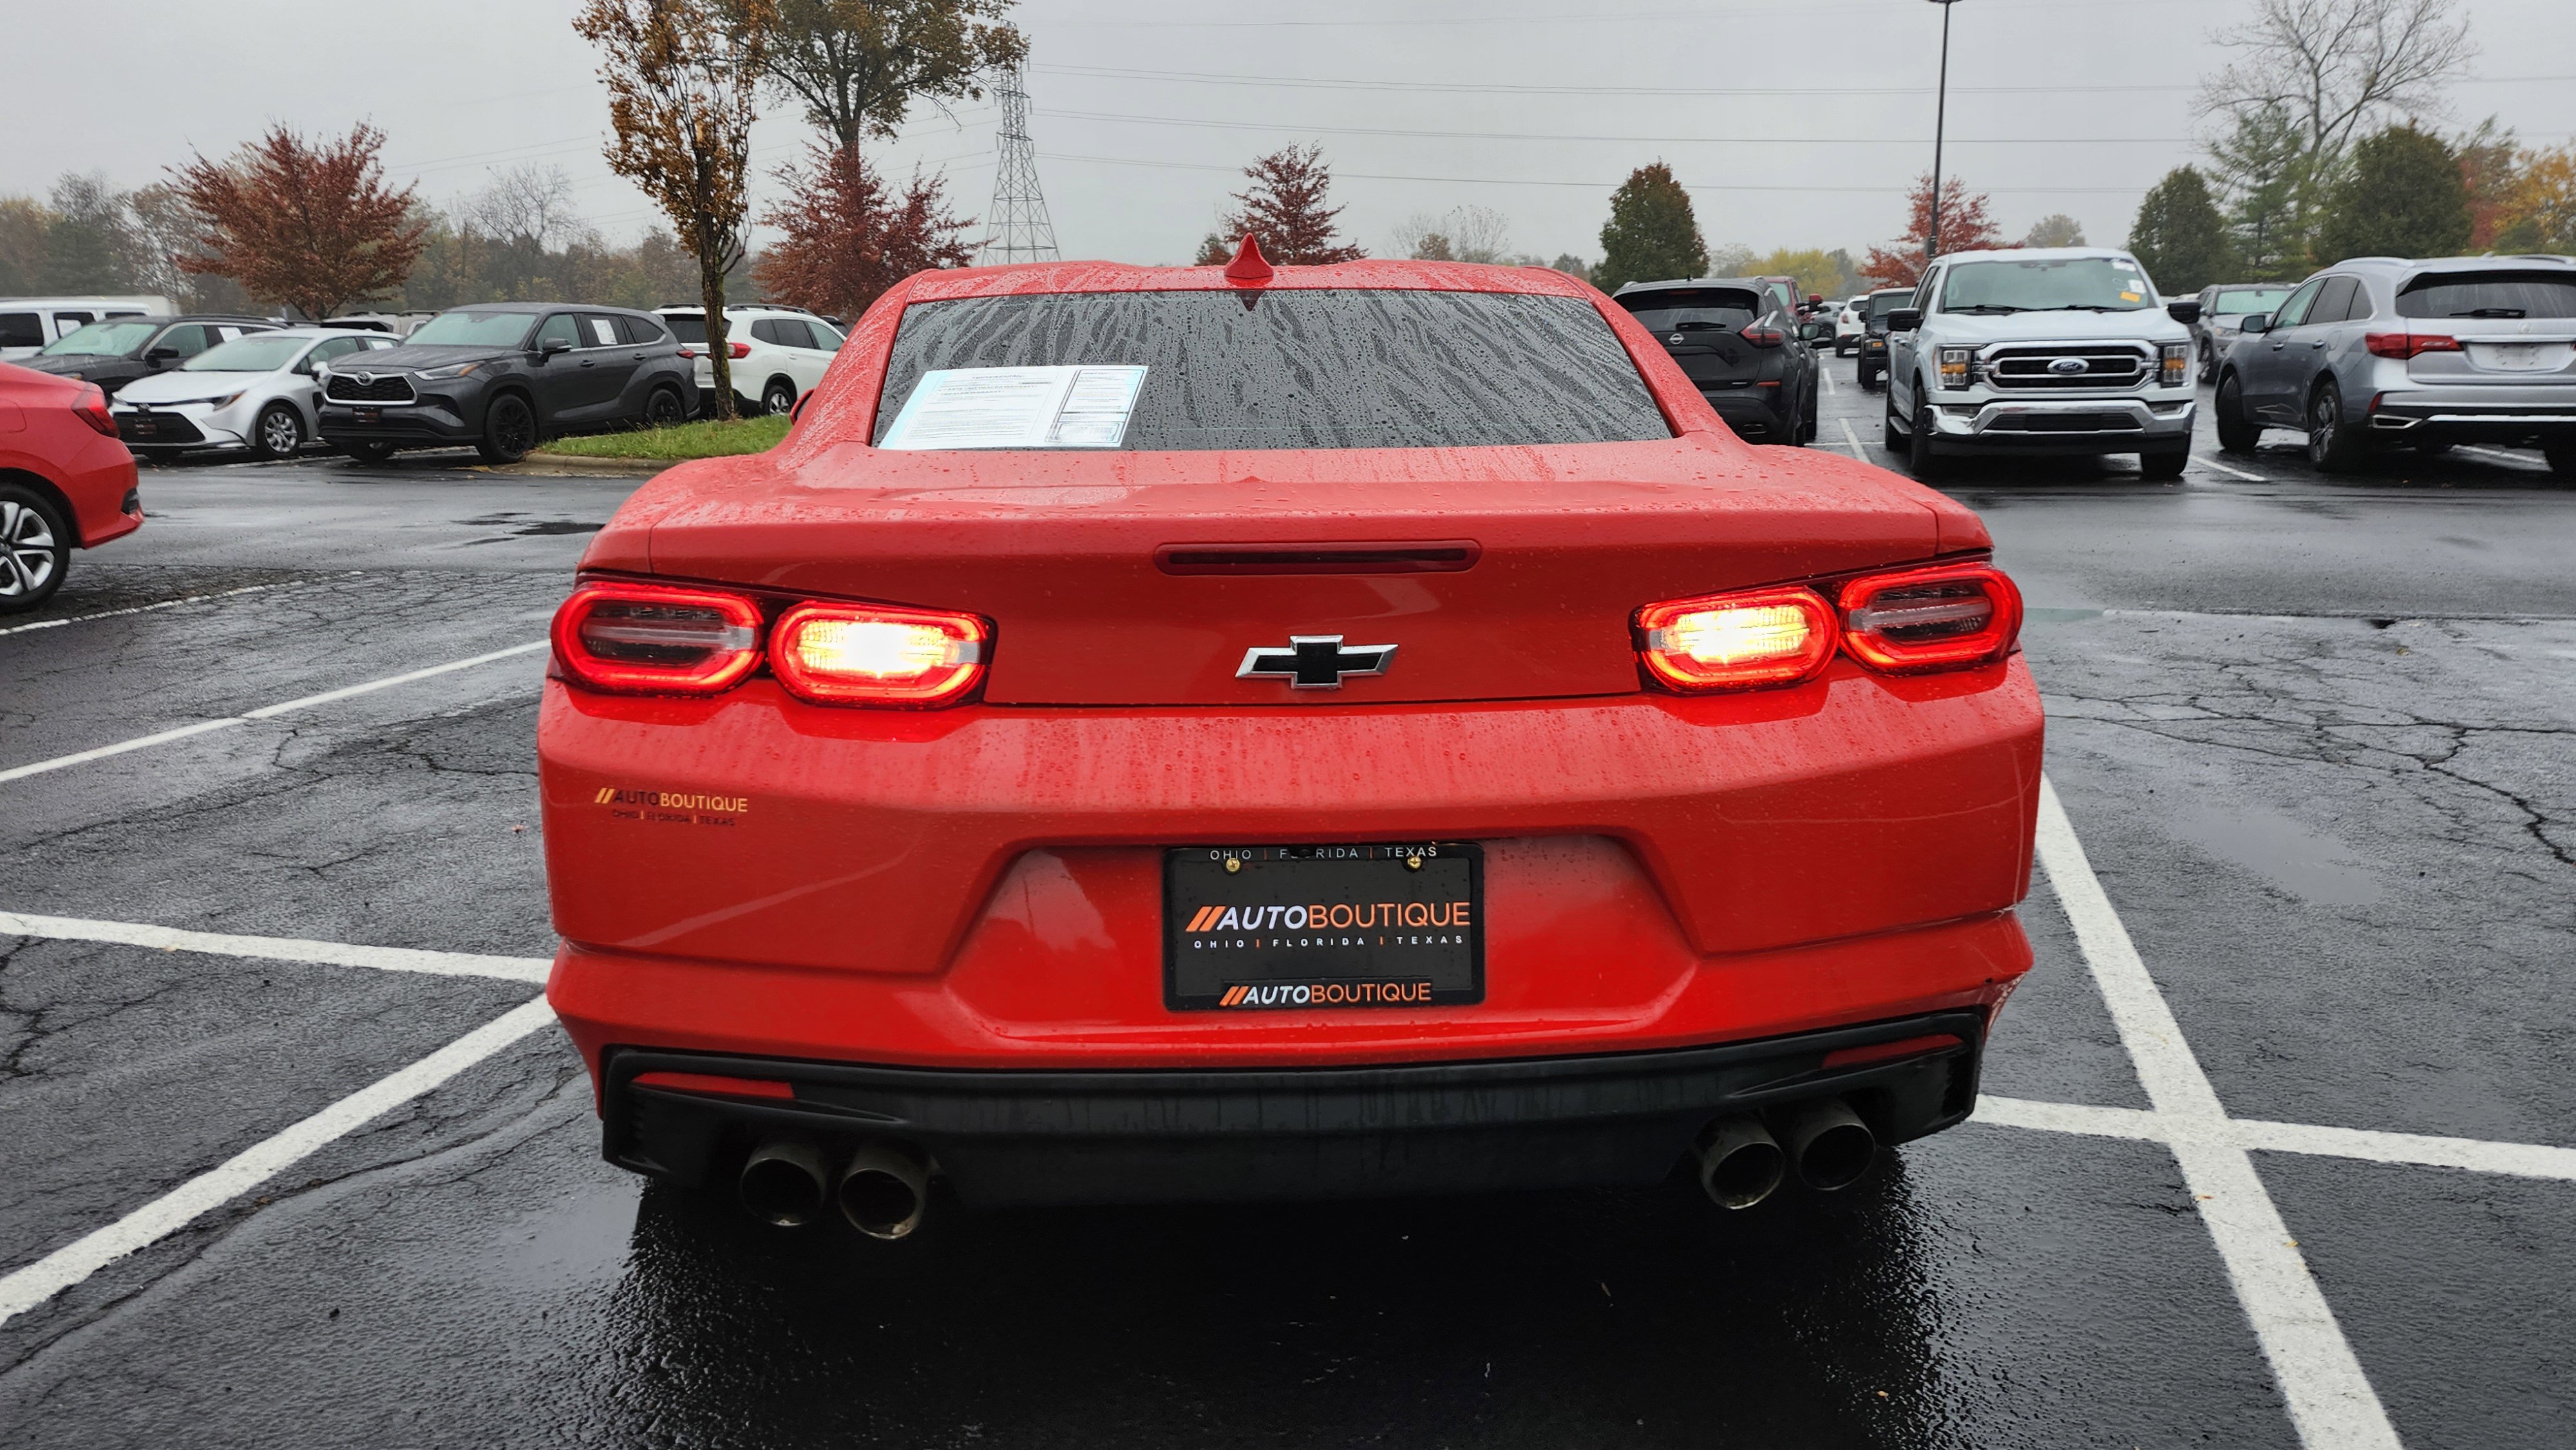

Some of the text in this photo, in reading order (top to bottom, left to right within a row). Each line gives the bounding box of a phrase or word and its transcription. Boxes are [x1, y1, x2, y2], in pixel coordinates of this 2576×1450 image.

[2058, 362, 2079, 370] Ford
[613, 789, 748, 812] AUTOBOUTIQUE
[699, 815, 735, 826] TEXAS
[1210, 847, 1437, 860] OHIO FRIDA TEXAS
[1217, 902, 1471, 930] AUTOBOUTIQUE
[1194, 935, 1463, 949] OHIO FLORIDA TEXAS
[1242, 983, 1432, 1005] AUTOBOUTIQUE
